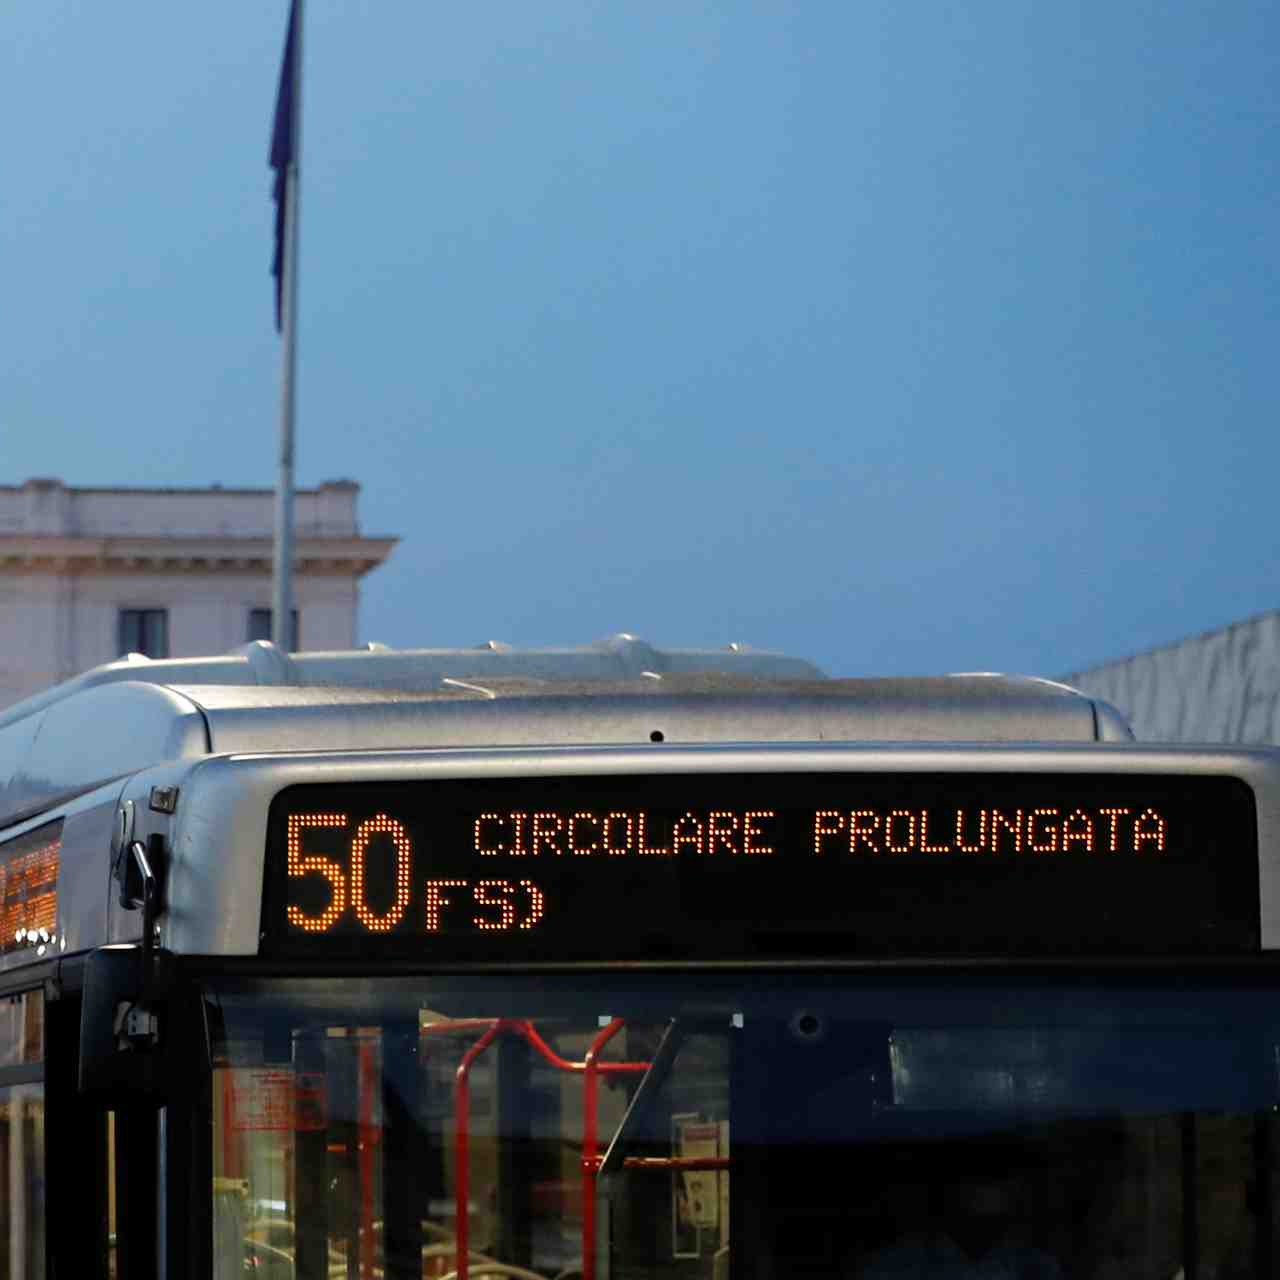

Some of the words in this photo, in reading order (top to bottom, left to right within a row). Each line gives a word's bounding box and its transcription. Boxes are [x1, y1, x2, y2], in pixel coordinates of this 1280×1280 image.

[287, 813, 410, 932] 50
[474, 811, 776, 856] CIRCOLARE
[814, 808, 1164, 853] PROLUNGATA
